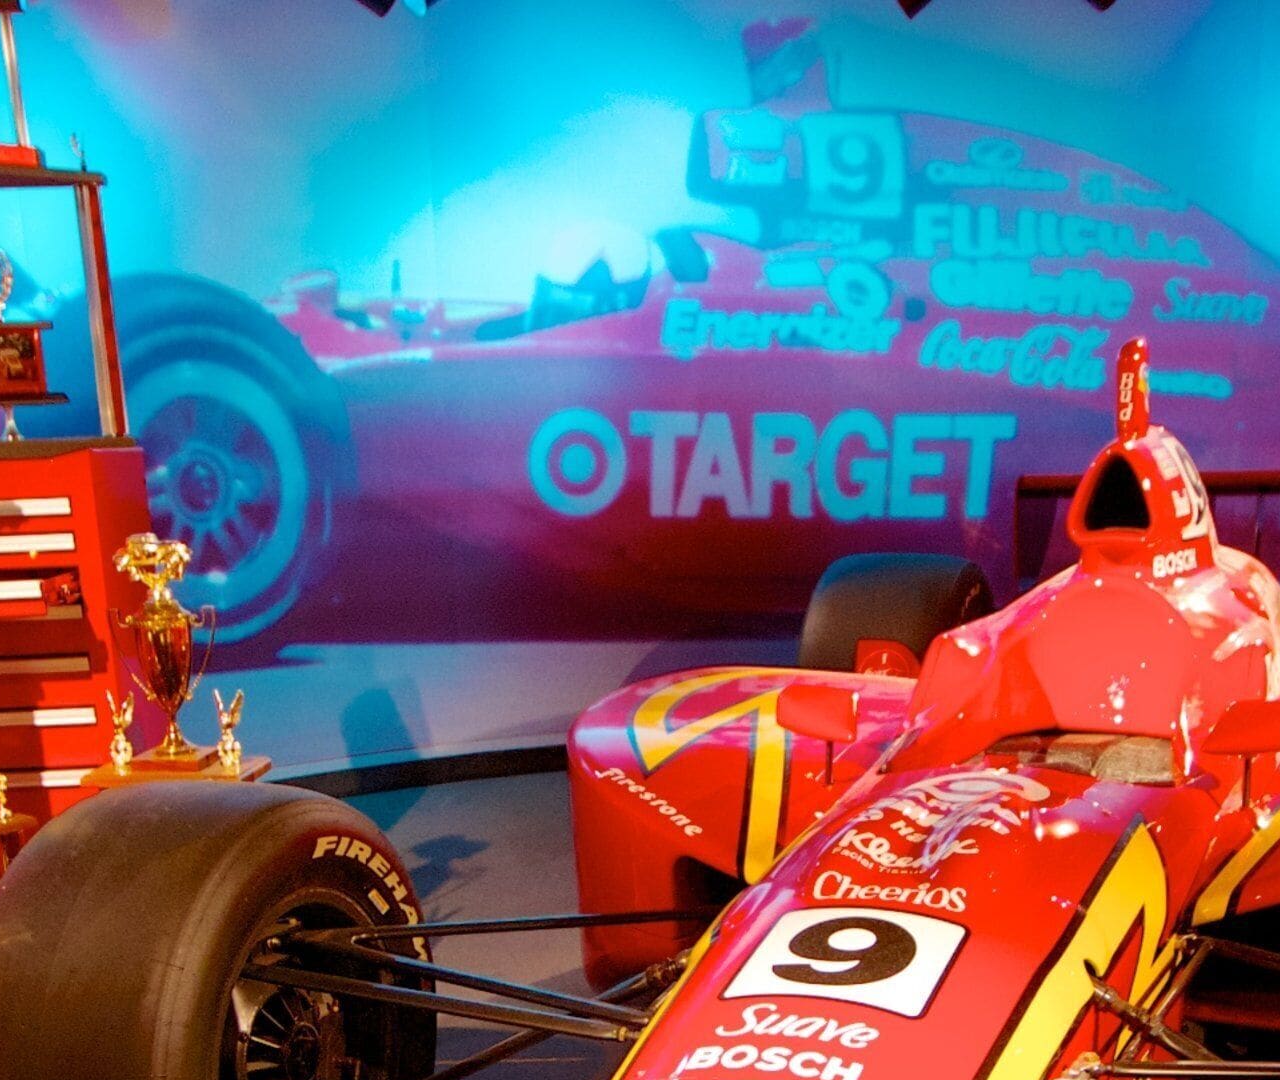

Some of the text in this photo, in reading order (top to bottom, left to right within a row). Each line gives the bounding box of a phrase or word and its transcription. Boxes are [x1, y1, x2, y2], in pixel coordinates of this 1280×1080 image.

[827, 132, 885, 203] 9
[1153, 277, 1270, 325] Suave
[631, 411, 1018, 520] TARGET
[1152, 548, 1197, 578] BOSCH
[594, 766, 703, 838] Firestone
[839, 829, 980, 868] Kleex
[813, 870, 967, 912] Cheerios
[772, 917, 917, 986] 9
[716, 1004, 880, 1048] Suave
